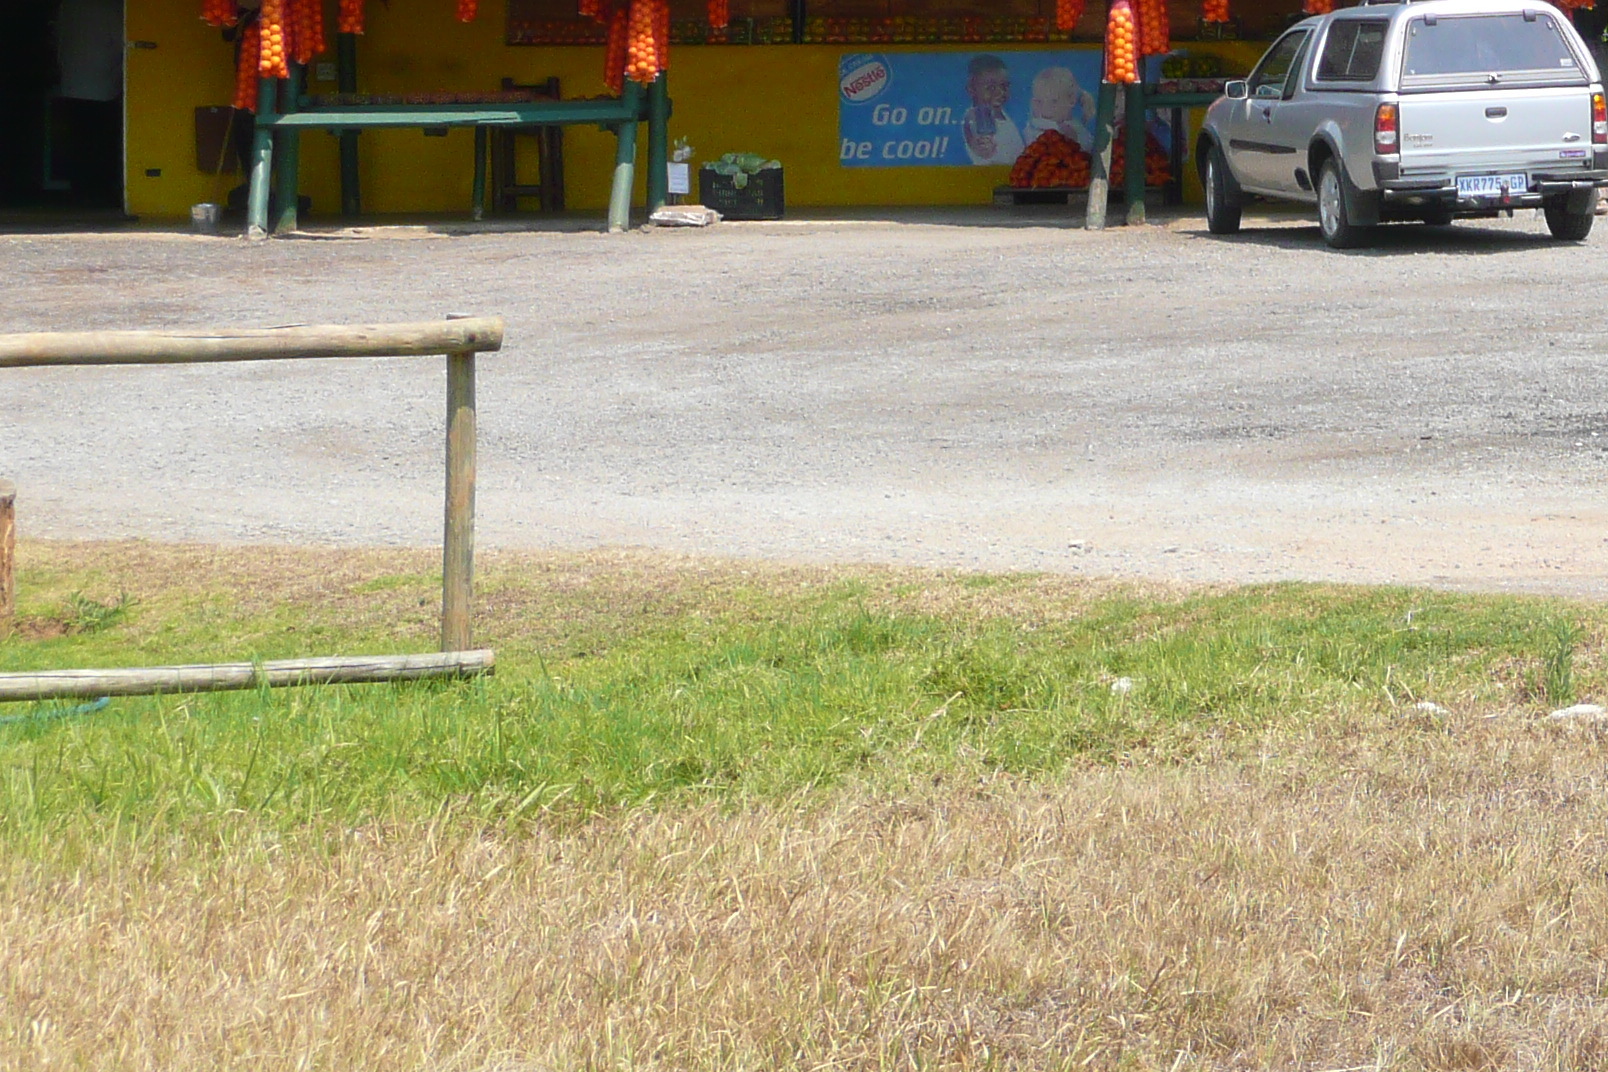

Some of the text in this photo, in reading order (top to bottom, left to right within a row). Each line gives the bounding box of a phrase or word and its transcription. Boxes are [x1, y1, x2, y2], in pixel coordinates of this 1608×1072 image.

[872, 103, 908, 126] Go
[840, 136, 949, 159] be cool!
[1458, 175, 1524, 192] XKR775 GP
